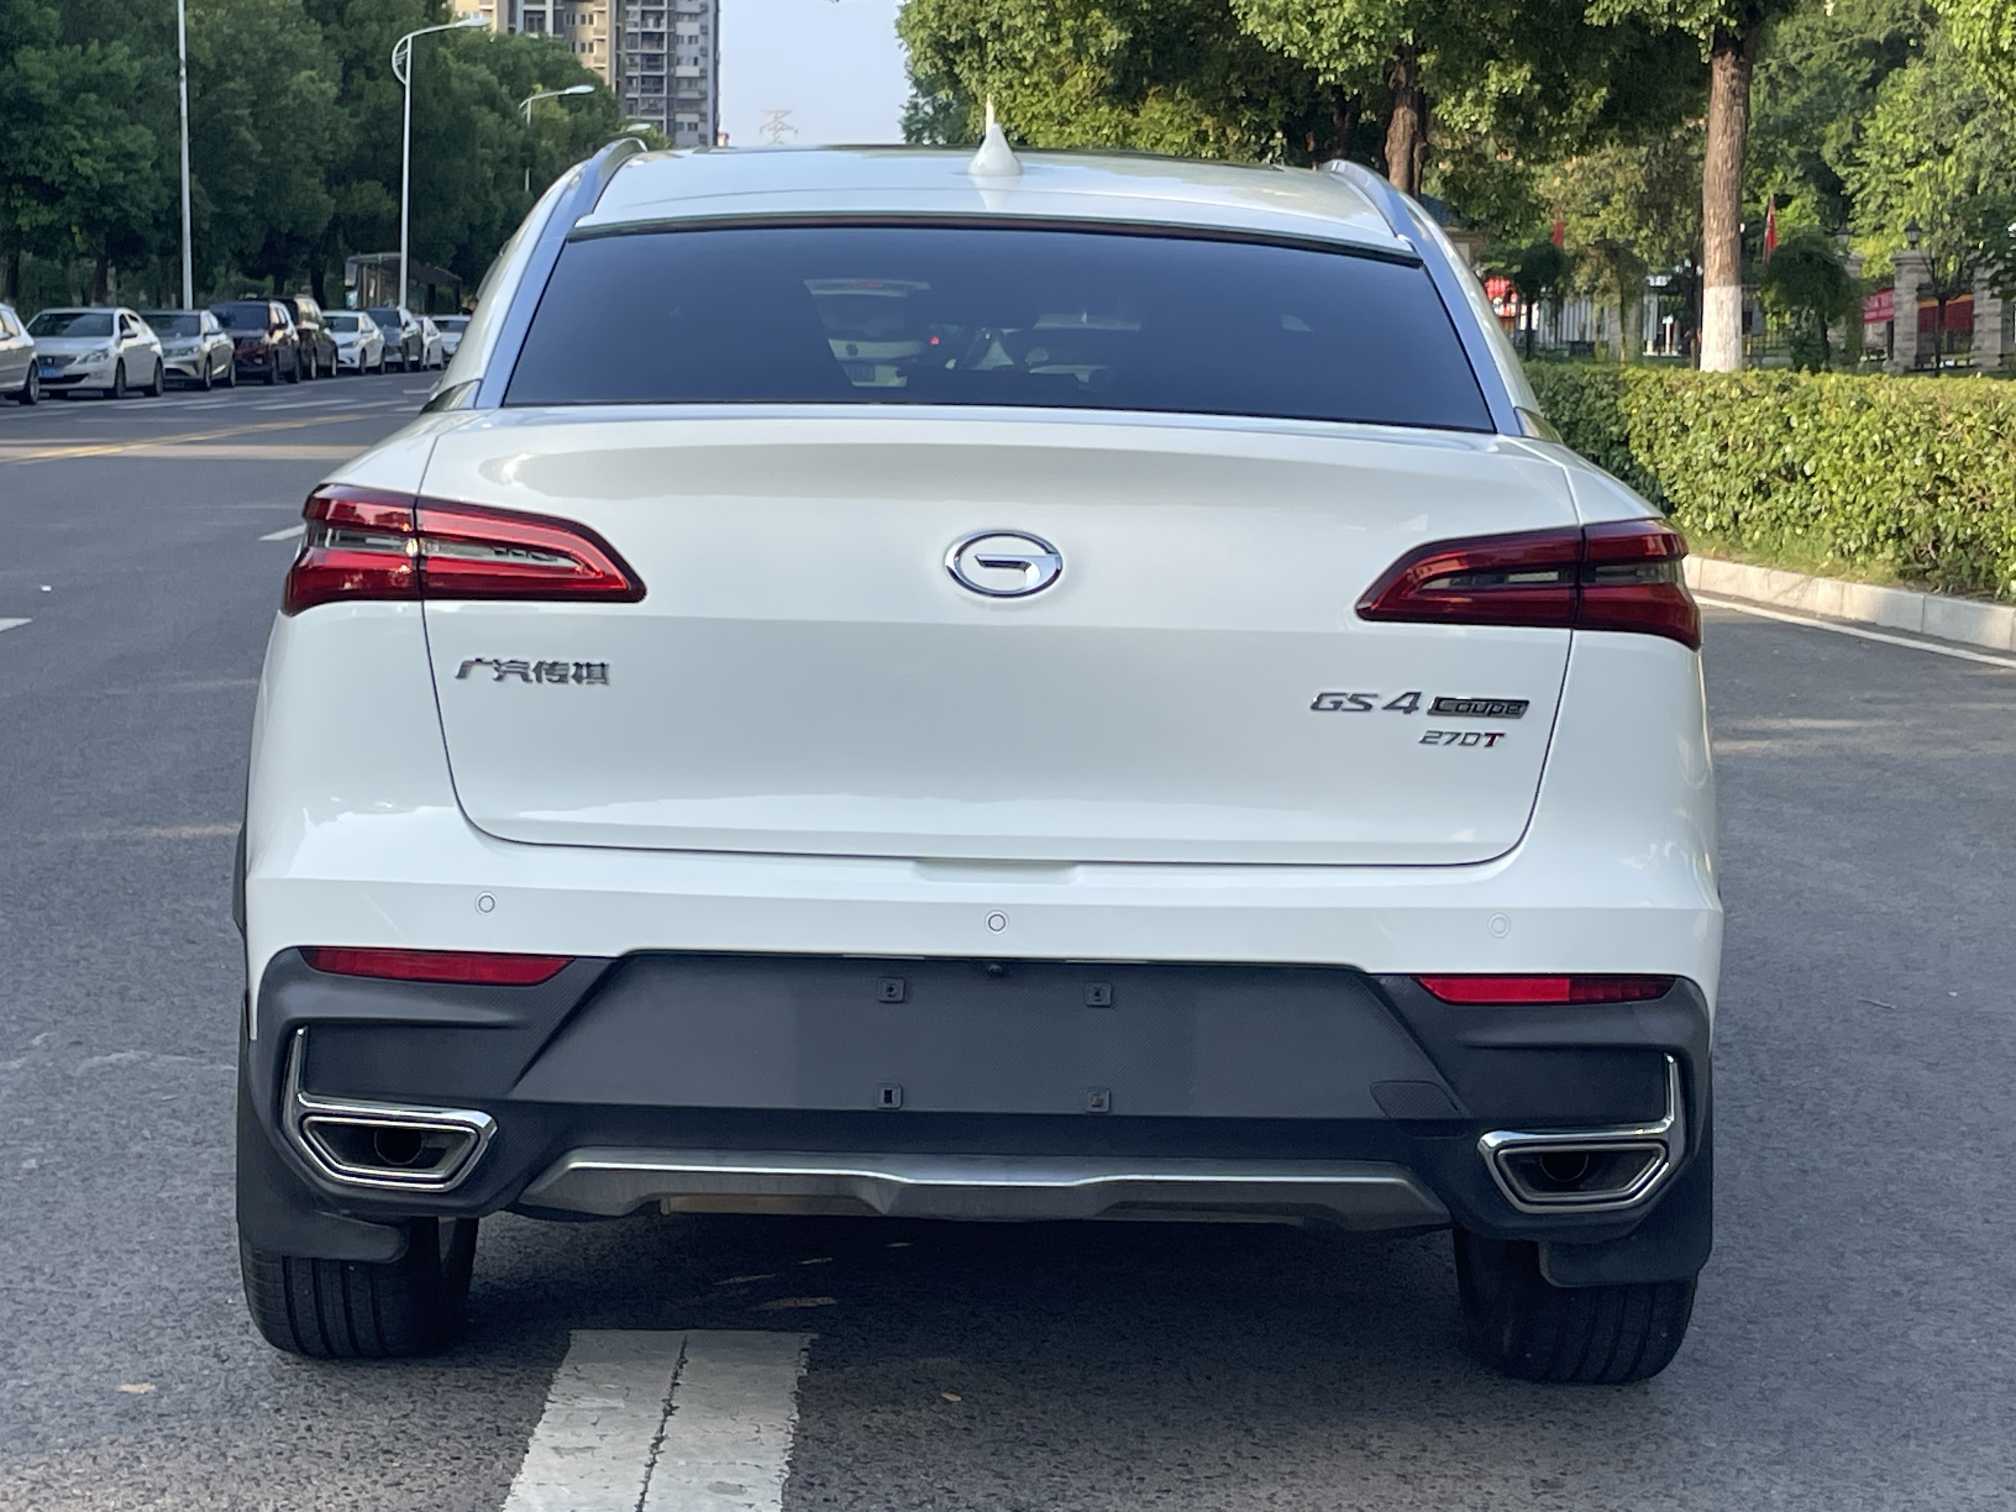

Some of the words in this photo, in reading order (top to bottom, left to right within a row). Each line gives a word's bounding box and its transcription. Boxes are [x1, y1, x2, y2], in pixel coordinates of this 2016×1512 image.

[455, 657, 610, 686] 广汽传祺
[1419, 730, 1505, 748] 270T
